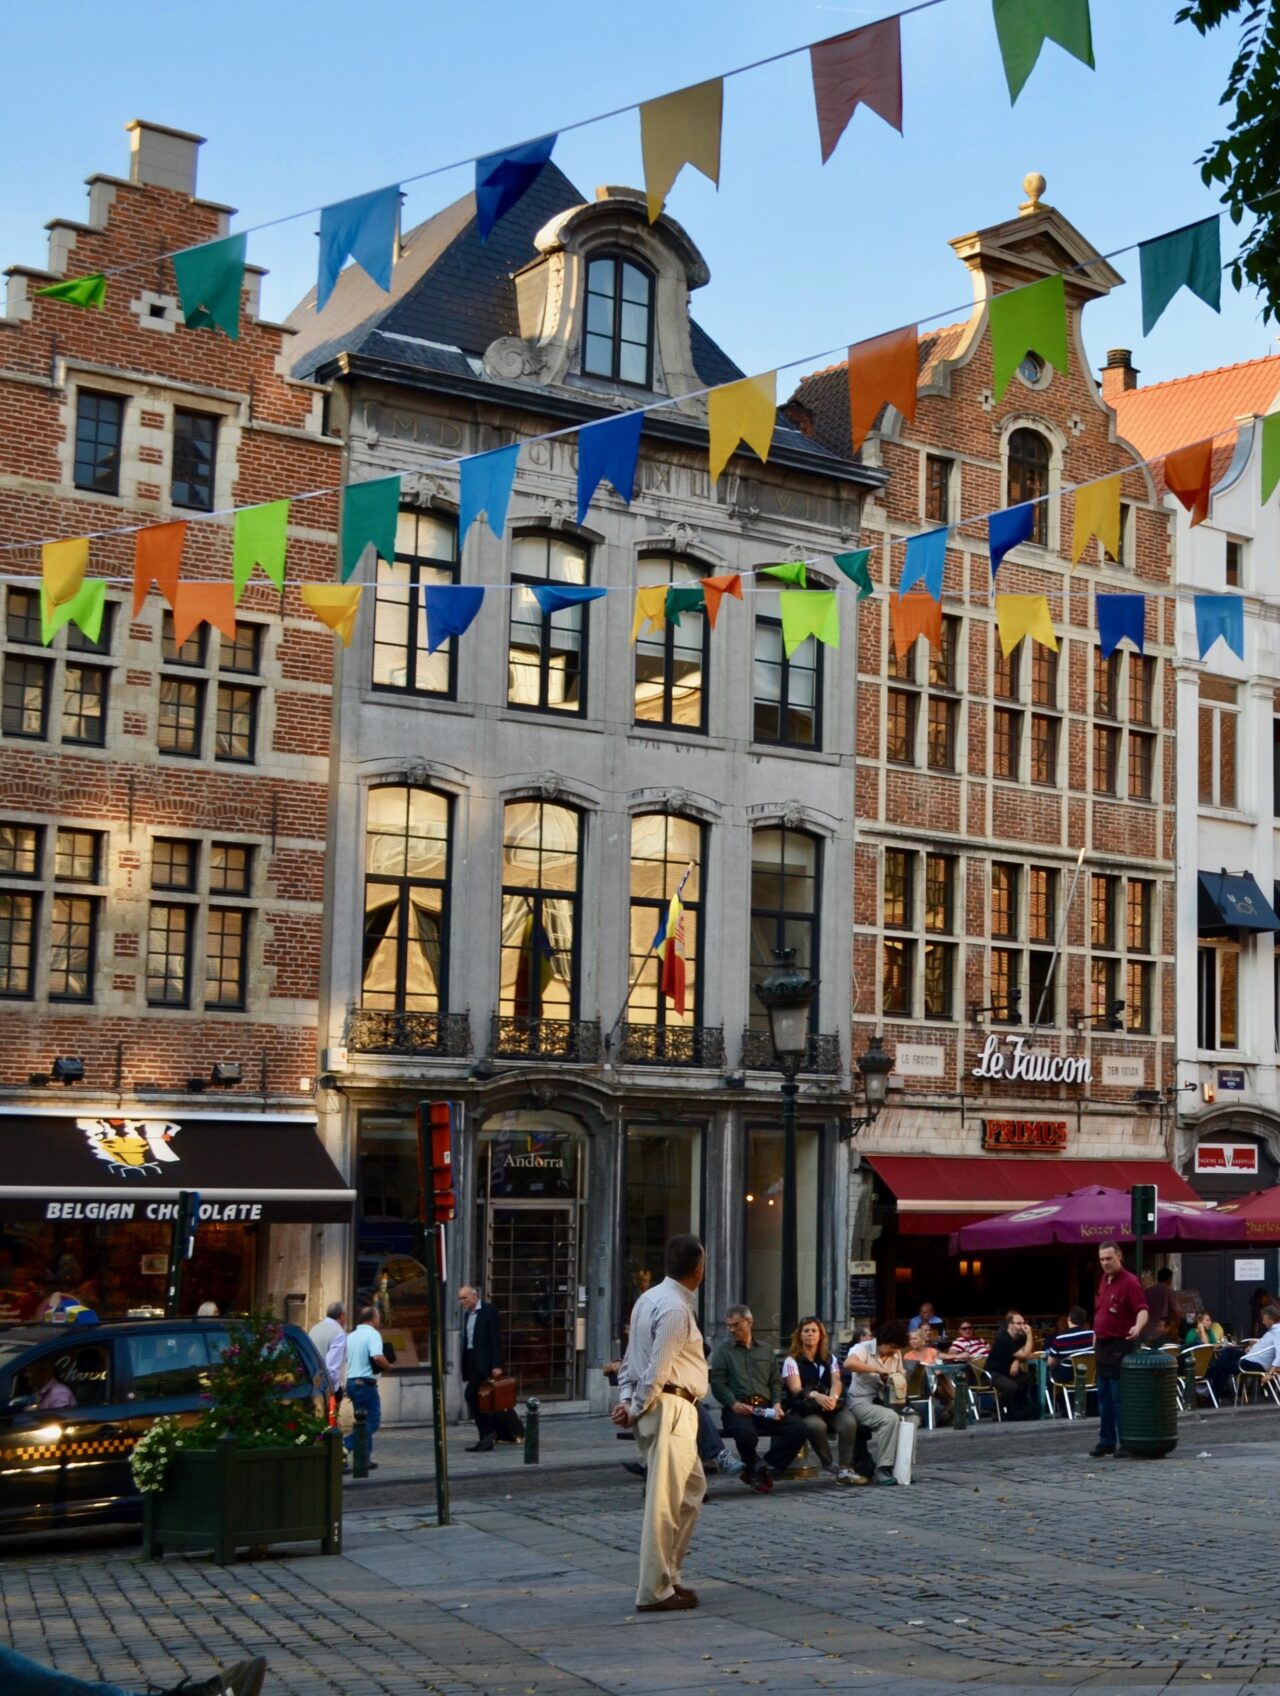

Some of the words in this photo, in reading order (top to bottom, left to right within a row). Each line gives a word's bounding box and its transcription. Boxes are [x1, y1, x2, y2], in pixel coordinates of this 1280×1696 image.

[972, 1034, 1004, 1079] Le
[1004, 1036, 1093, 1084] Faucon
[986, 1120, 1067, 1143] PRIMUS
[503, 1153, 563, 1168] Andorra
[46, 1203, 134, 1219] BELGIAN
[146, 1204, 262, 1221] CHOOLATE
[1080, 1223, 1116, 1237] Keizer
